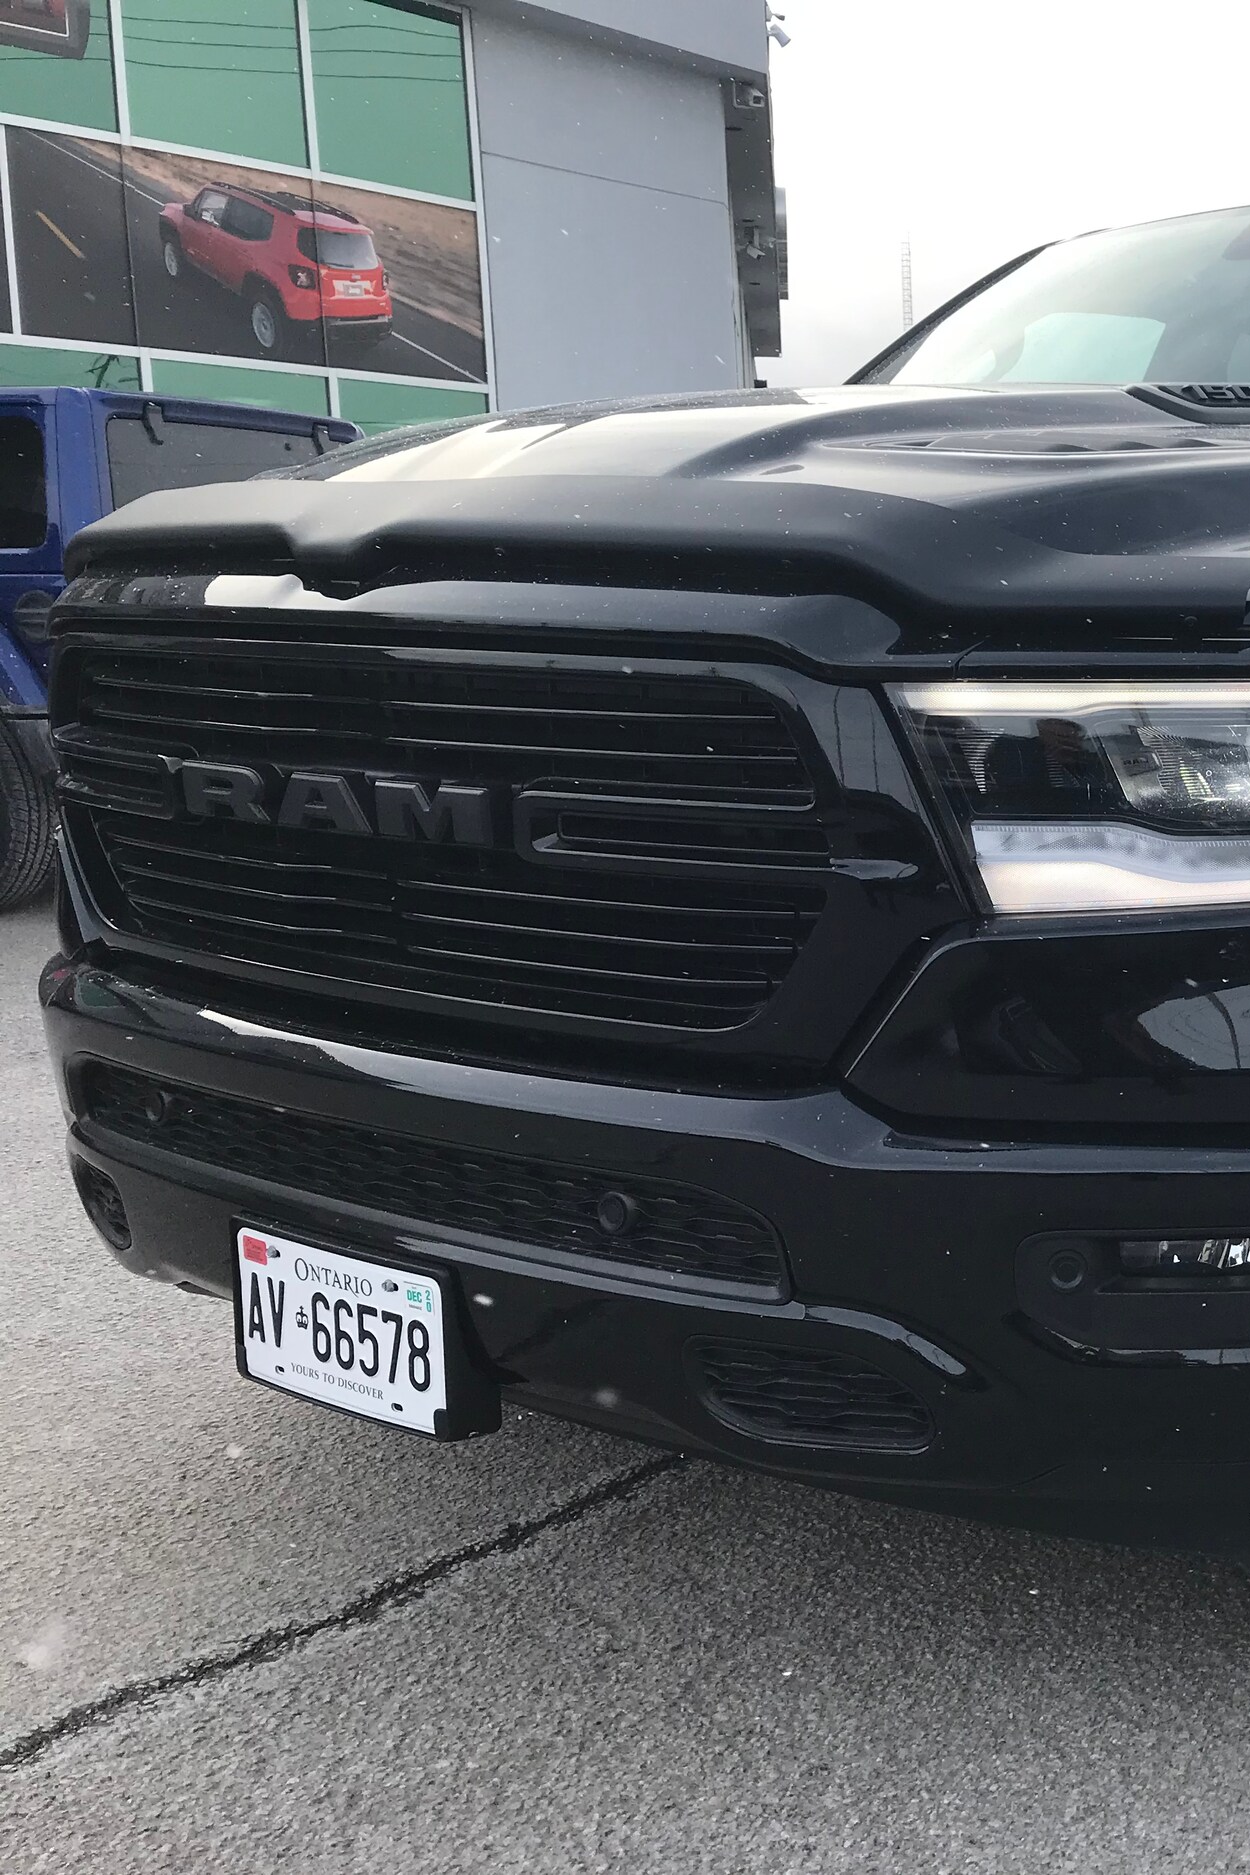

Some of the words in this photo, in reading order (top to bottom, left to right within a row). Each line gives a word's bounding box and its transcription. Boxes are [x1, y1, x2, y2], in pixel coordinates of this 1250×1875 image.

[182, 759, 494, 848] RAM
[406, 1289, 422, 1303] DEC
[249, 1272, 285, 1348] AV
[311, 1292, 430, 1392] 66578
[290, 1362, 319, 1380] YOURS
[322, 1372, 335, 1385] TO
[337, 1377, 384, 1400] DISCOVER
